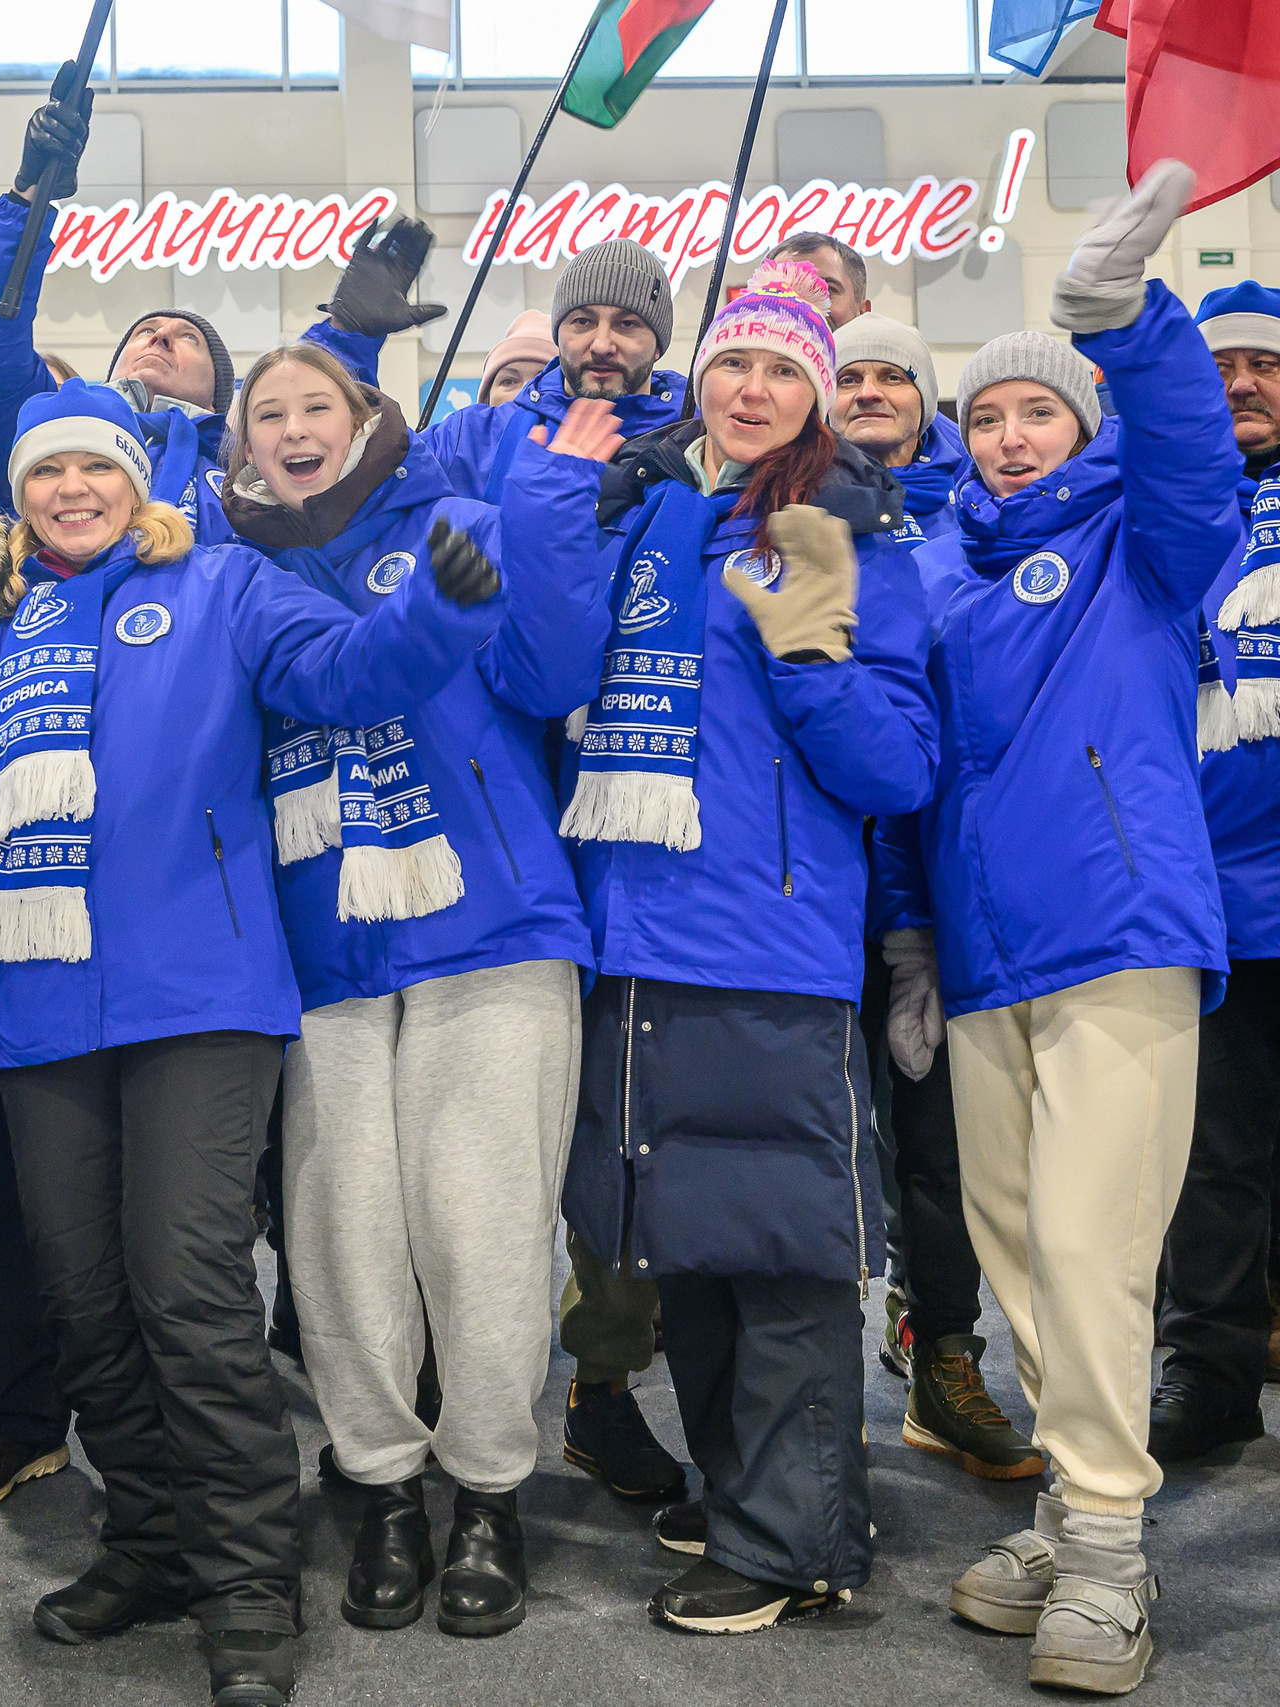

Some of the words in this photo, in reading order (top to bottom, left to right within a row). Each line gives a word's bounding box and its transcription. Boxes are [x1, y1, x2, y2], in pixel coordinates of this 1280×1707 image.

[46, 195, 390, 276] тличное
[715, 322, 834, 398] AIR-FORCE
[0, 679, 69, 714] СЕРВИСА
[602, 693, 673, 713] СЕРВИСА
